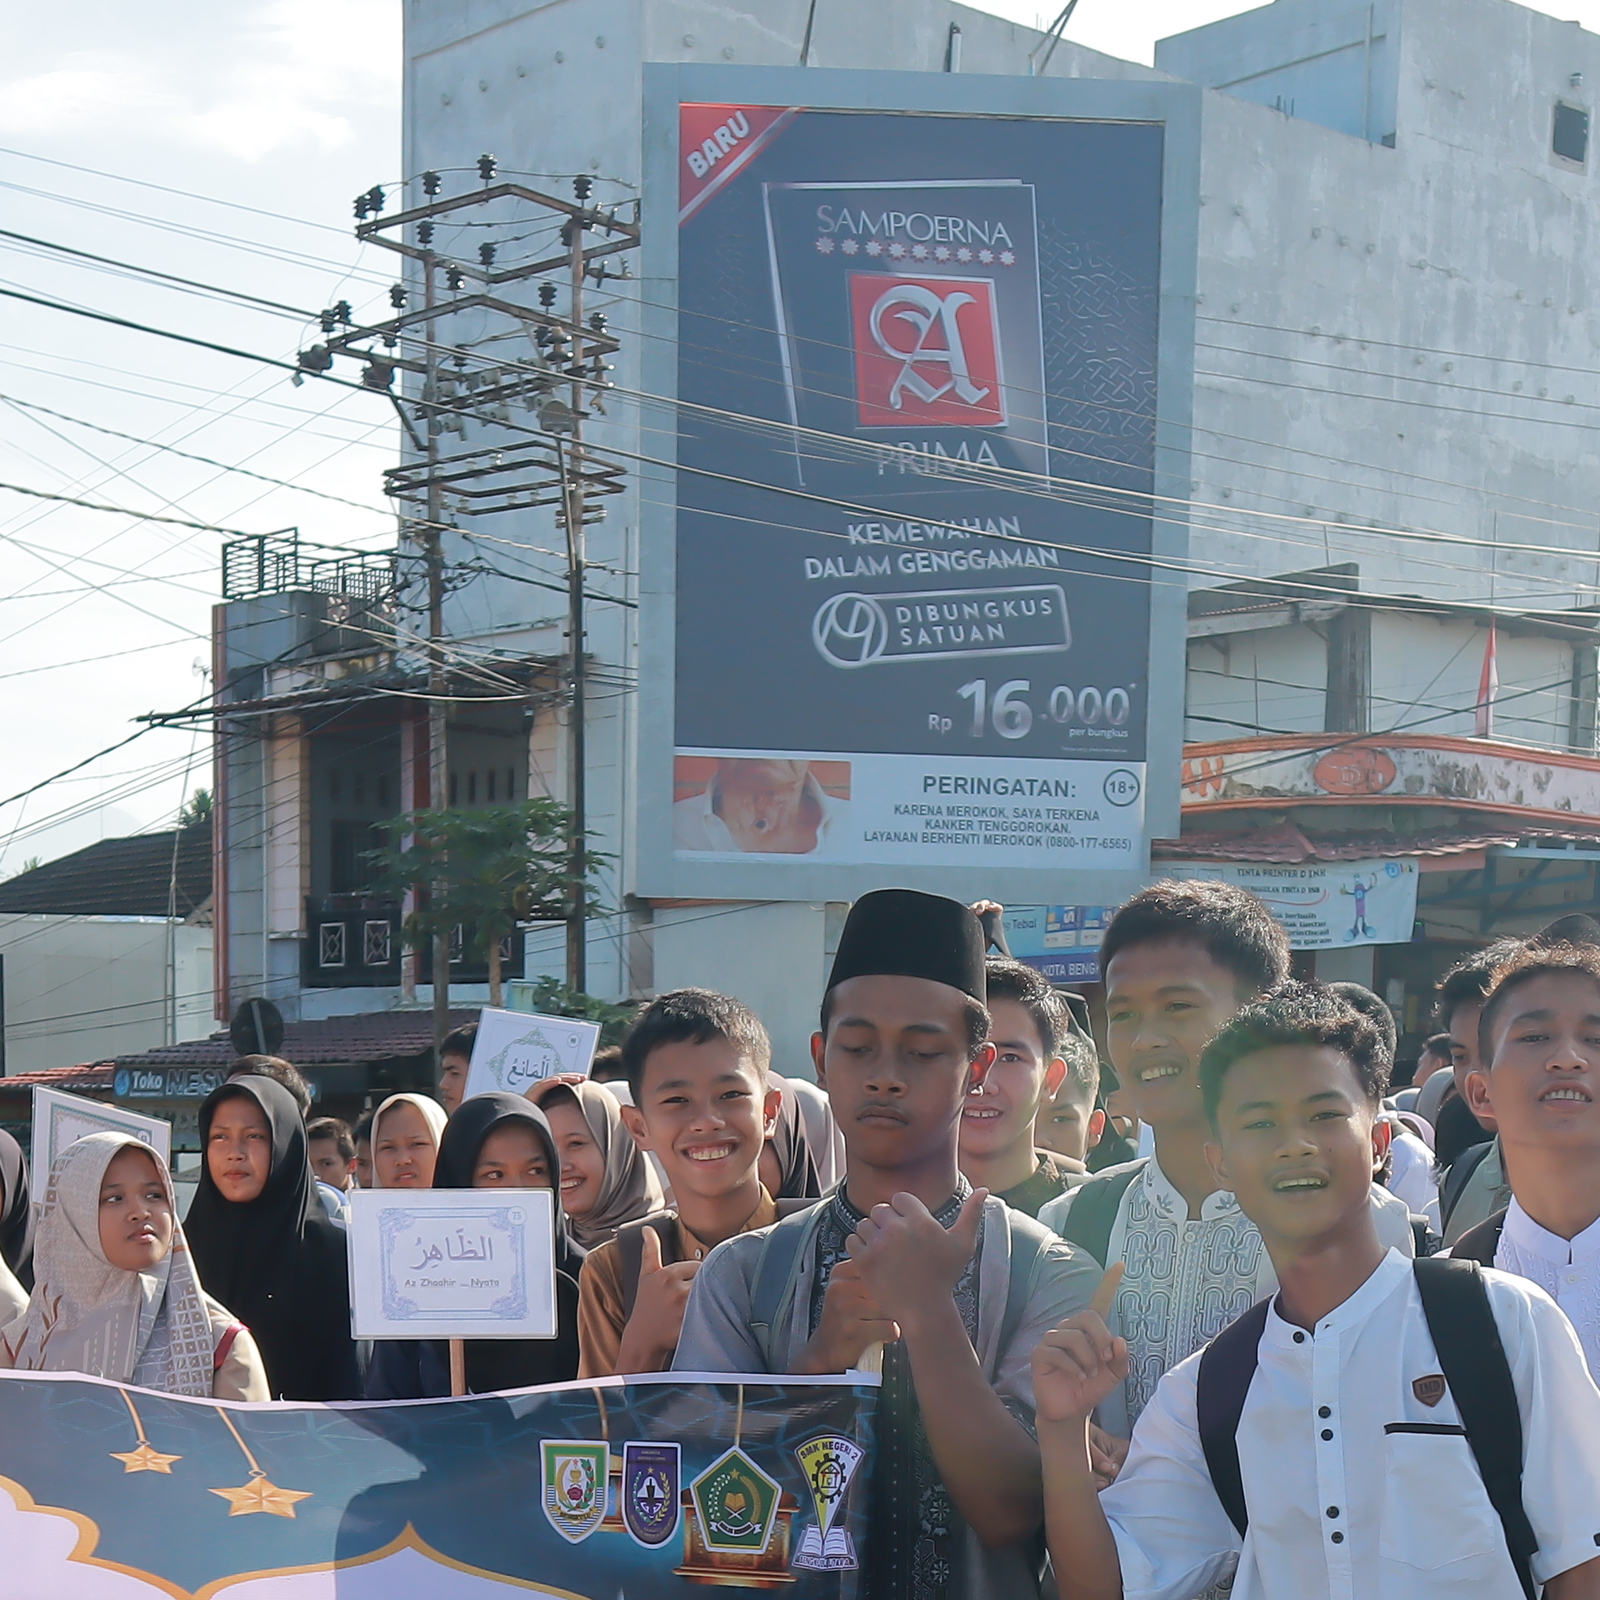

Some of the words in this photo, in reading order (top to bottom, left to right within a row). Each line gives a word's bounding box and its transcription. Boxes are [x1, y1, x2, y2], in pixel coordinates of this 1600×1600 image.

[686, 110, 751, 178] BARU
[817, 205, 1012, 248] SAMPOERNA
[878, 440, 999, 476] PRIMA
[847, 515, 1022, 546] KEMEWAHAN
[804, 555, 892, 580] DALAM
[898, 547, 1059, 575] GENGGAMAN
[896, 598, 1052, 624] DIBUNGKUS
[901, 622, 1005, 647] SATUAN
[928, 714, 952, 734] Rp
[1069, 728, 1085, 738] per
[1088, 727, 1128, 739] bungkus
[923, 775, 1076, 797] PERINGATAN:
[1109, 780, 1136, 795] 18+
[894, 804, 943, 816] KARENA
[947, 806, 1009, 819] MEROKOK,
[1013, 807, 1041, 819] SAYA
[1046, 809, 1100, 821] TERKENA
[925, 819, 973, 831] KANKER
[978, 820, 1071, 834] TENGGOROKAN.
[864, 831, 918, 843] LAYANAN
[922, 832, 980, 845] BERHENTI
[984, 834, 1043, 847] MEROKOK
[1046, 836, 1132, 851] (0800-177-6565)
[132, 1071, 163, 1090] Toko
[800, 1445, 820, 1459] SMK
[822, 1441, 852, 1454] NEGERI
[851, 1452, 859, 1461] 2
